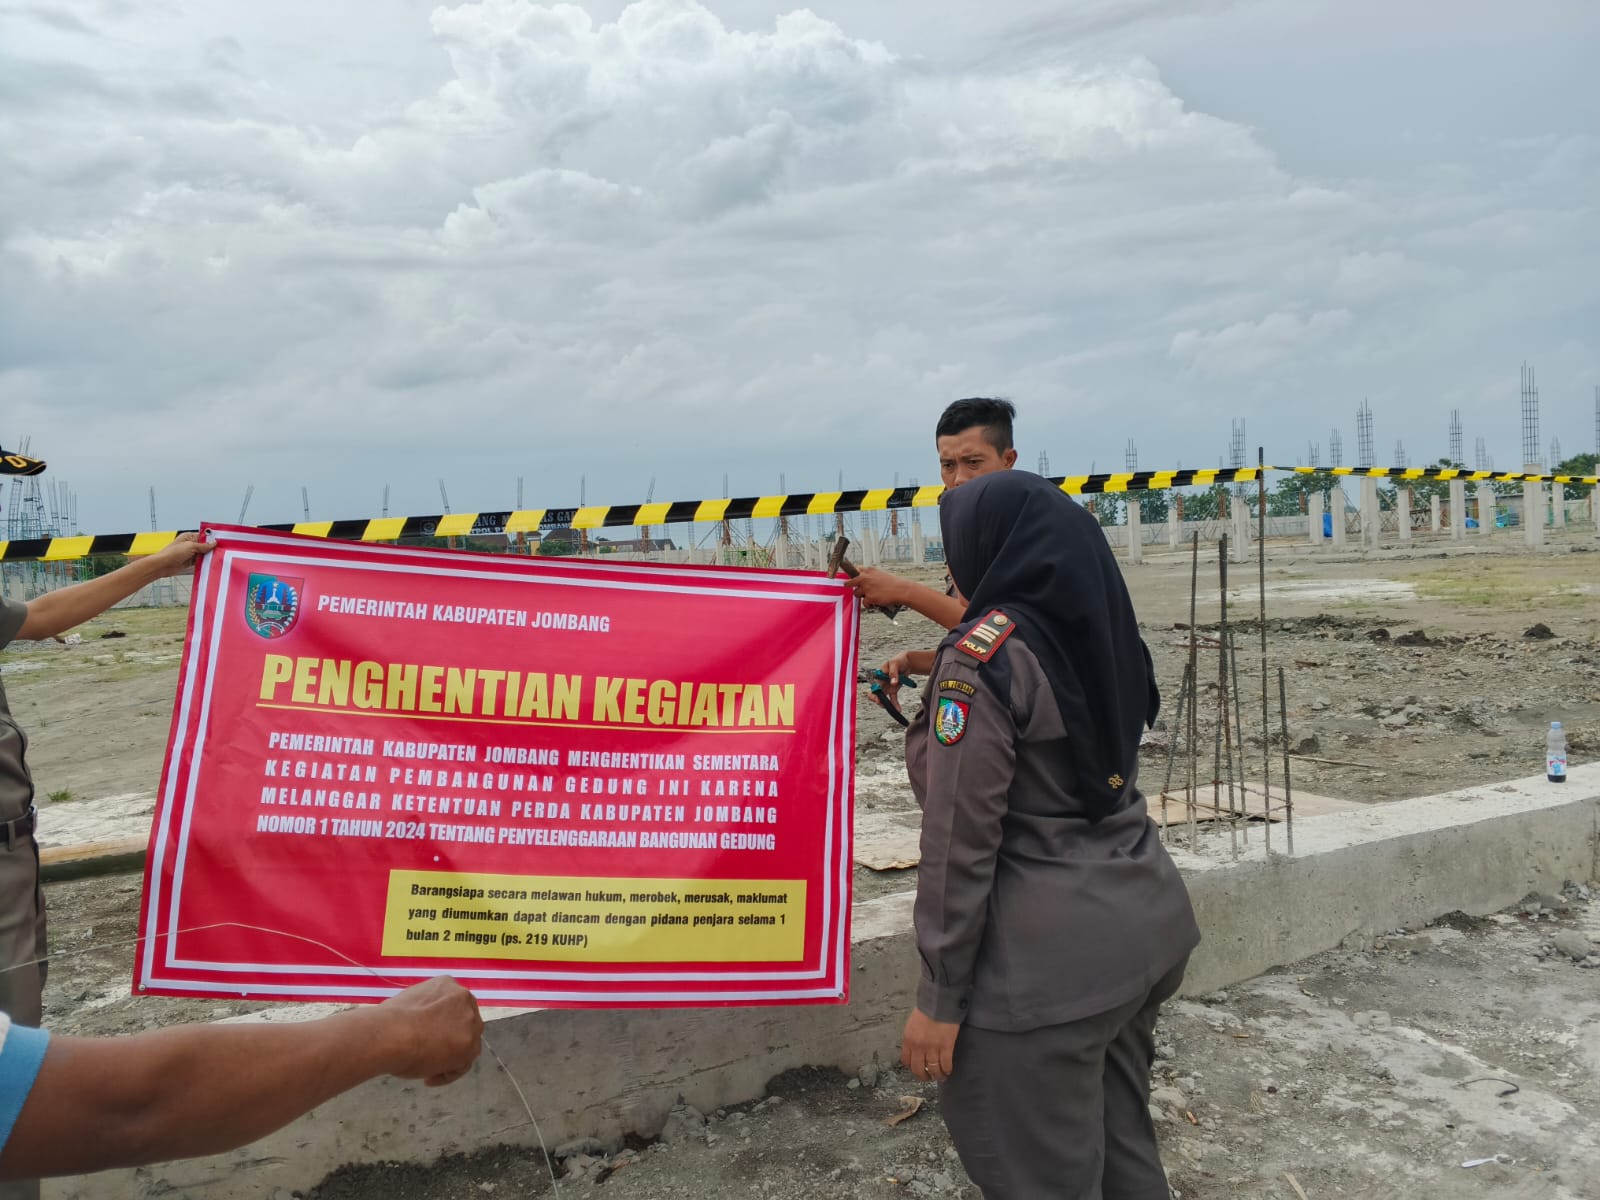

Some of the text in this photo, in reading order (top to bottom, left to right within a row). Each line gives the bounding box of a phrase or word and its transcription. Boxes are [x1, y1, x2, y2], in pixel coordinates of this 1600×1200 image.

[317, 594, 610, 633] PEMERINTAH KABUPATEN JOMBANG
[261, 654, 795, 727] PENGHENTIAN KEGIATAN
[268, 731, 779, 771] PEMERINTAH KABUPATEN JOMBANG MENGHENTIKAN SEMENTARA
[264, 759, 778, 797] KEGIATAN PEMBANGUNAN GEDUNG INI KARENA
[260, 786, 777, 824] MELANGGAR KETENTUAN PERDA KABUPATEN JOMBANG
[256, 814, 776, 850] NOMOR 1 TAHUN 2024 TENTANG PENYELENGGARAAN BANGUNAN GEDUNG
[410, 883, 788, 905] Barangsiapa secara melawan hukum, merobek, merusak, maklumat
[408, 907, 786, 928] yang diumumkan dapat diancam dengan pidana penjara selama 1
[406, 928, 588, 949] bulan 2 minggu (ps. 219 KUHP)
